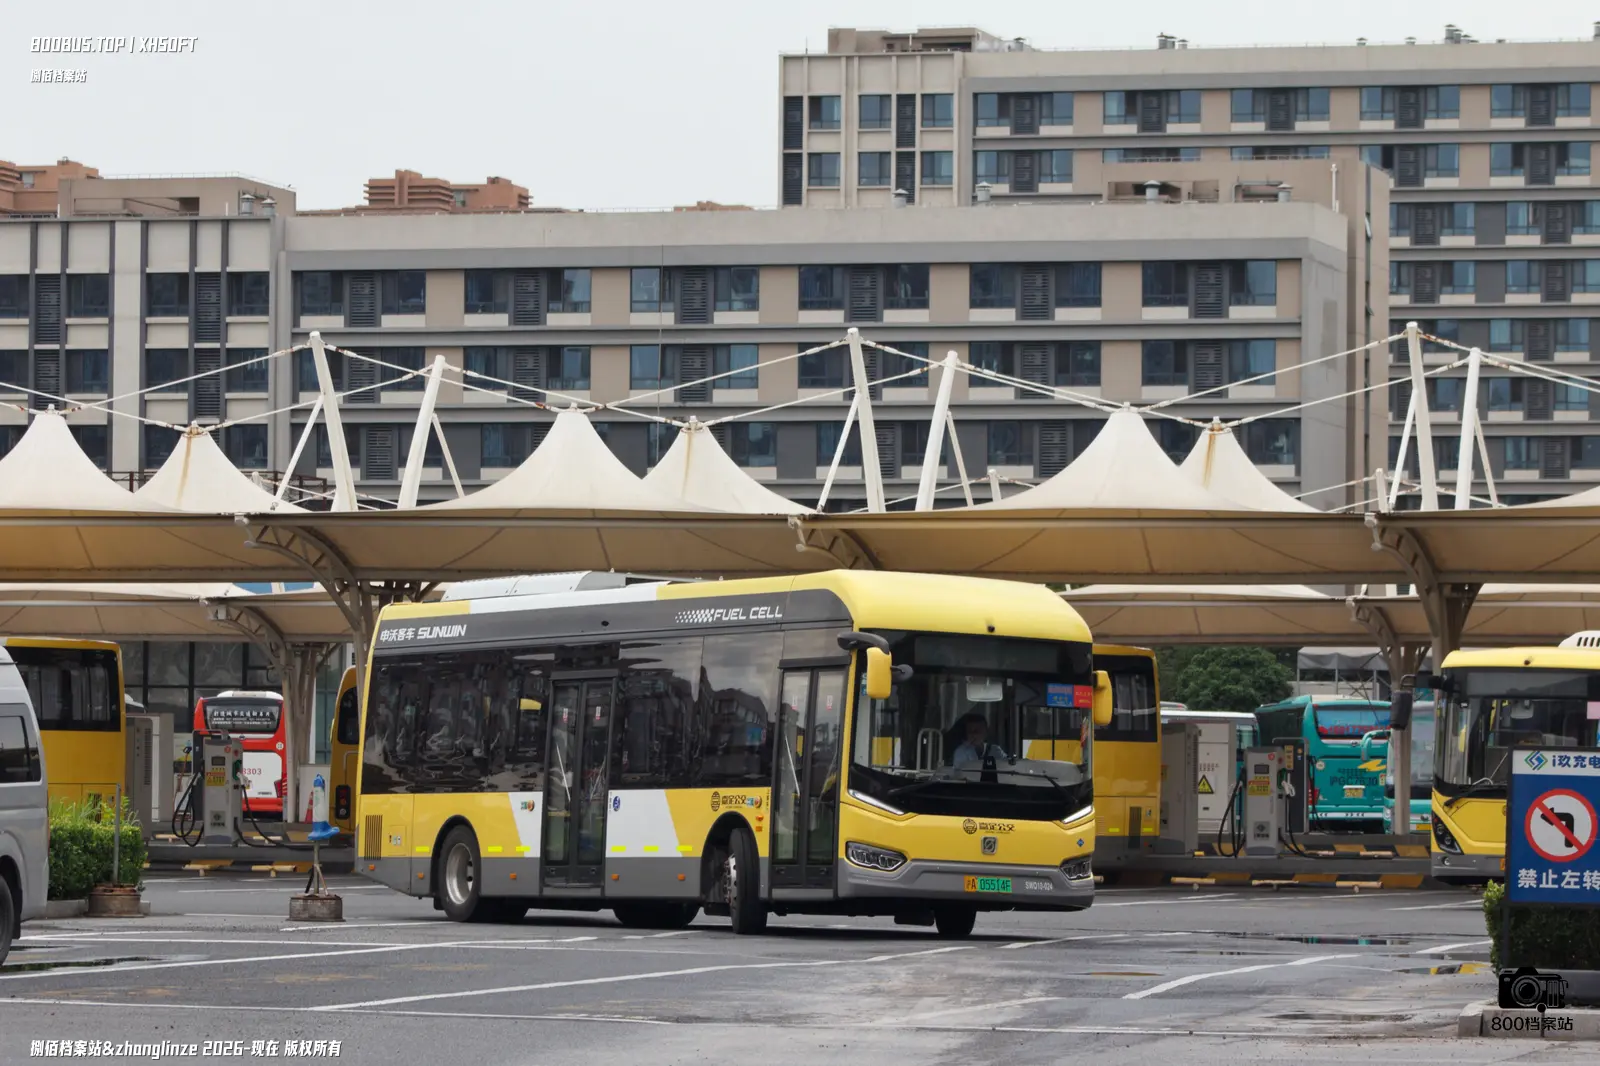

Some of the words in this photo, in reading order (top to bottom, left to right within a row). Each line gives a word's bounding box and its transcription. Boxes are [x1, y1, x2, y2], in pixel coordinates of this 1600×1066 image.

[713, 608, 747, 621] FUEL
[749, 605, 783, 619] CELL
[380, 627, 416, 642] 申沃客车
[417, 624, 467, 639] SUNWIN
[1517, 868, 1600, 891] 禁止左转
